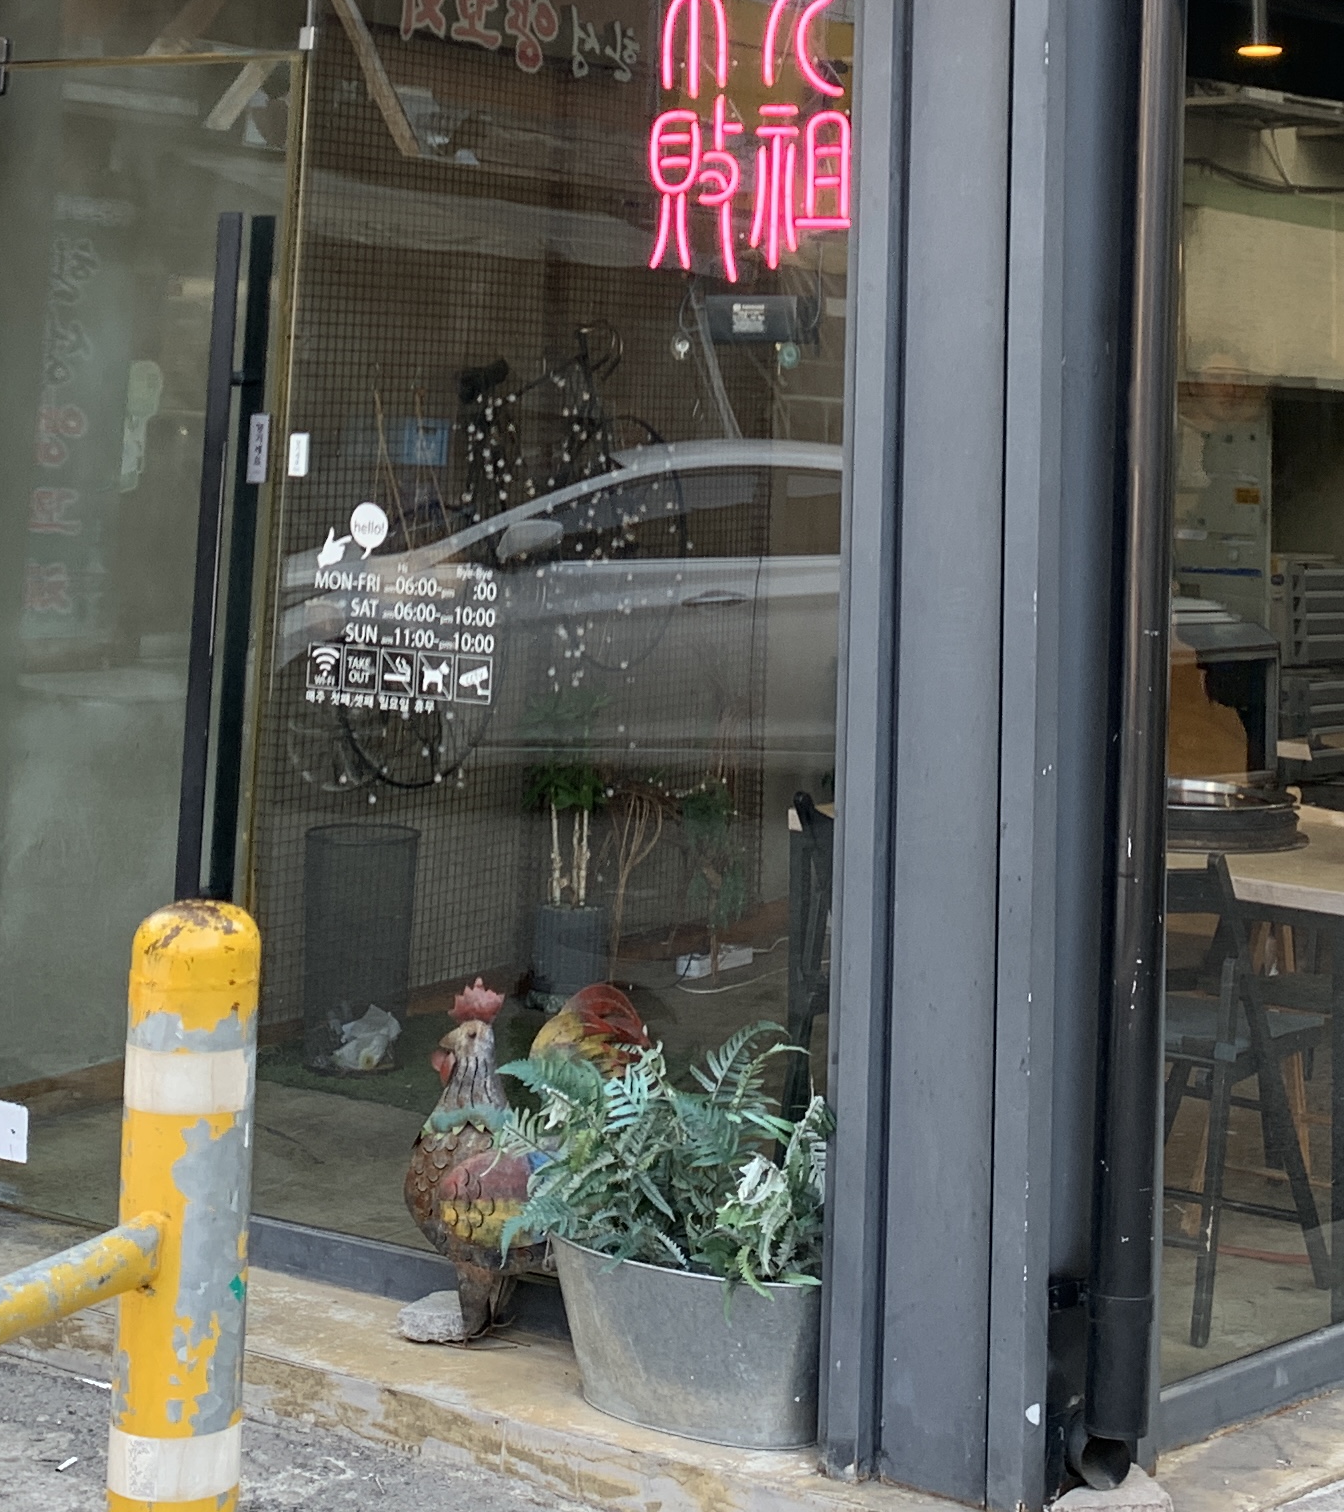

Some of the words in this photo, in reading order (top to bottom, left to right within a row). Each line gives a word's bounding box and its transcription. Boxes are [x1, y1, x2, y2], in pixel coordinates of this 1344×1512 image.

[314, 570, 381, 592] MON-FRI
[350, 597, 379, 618] SAT
[344, 621, 379, 644] SUN
[348, 671, 370, 684] OUT
